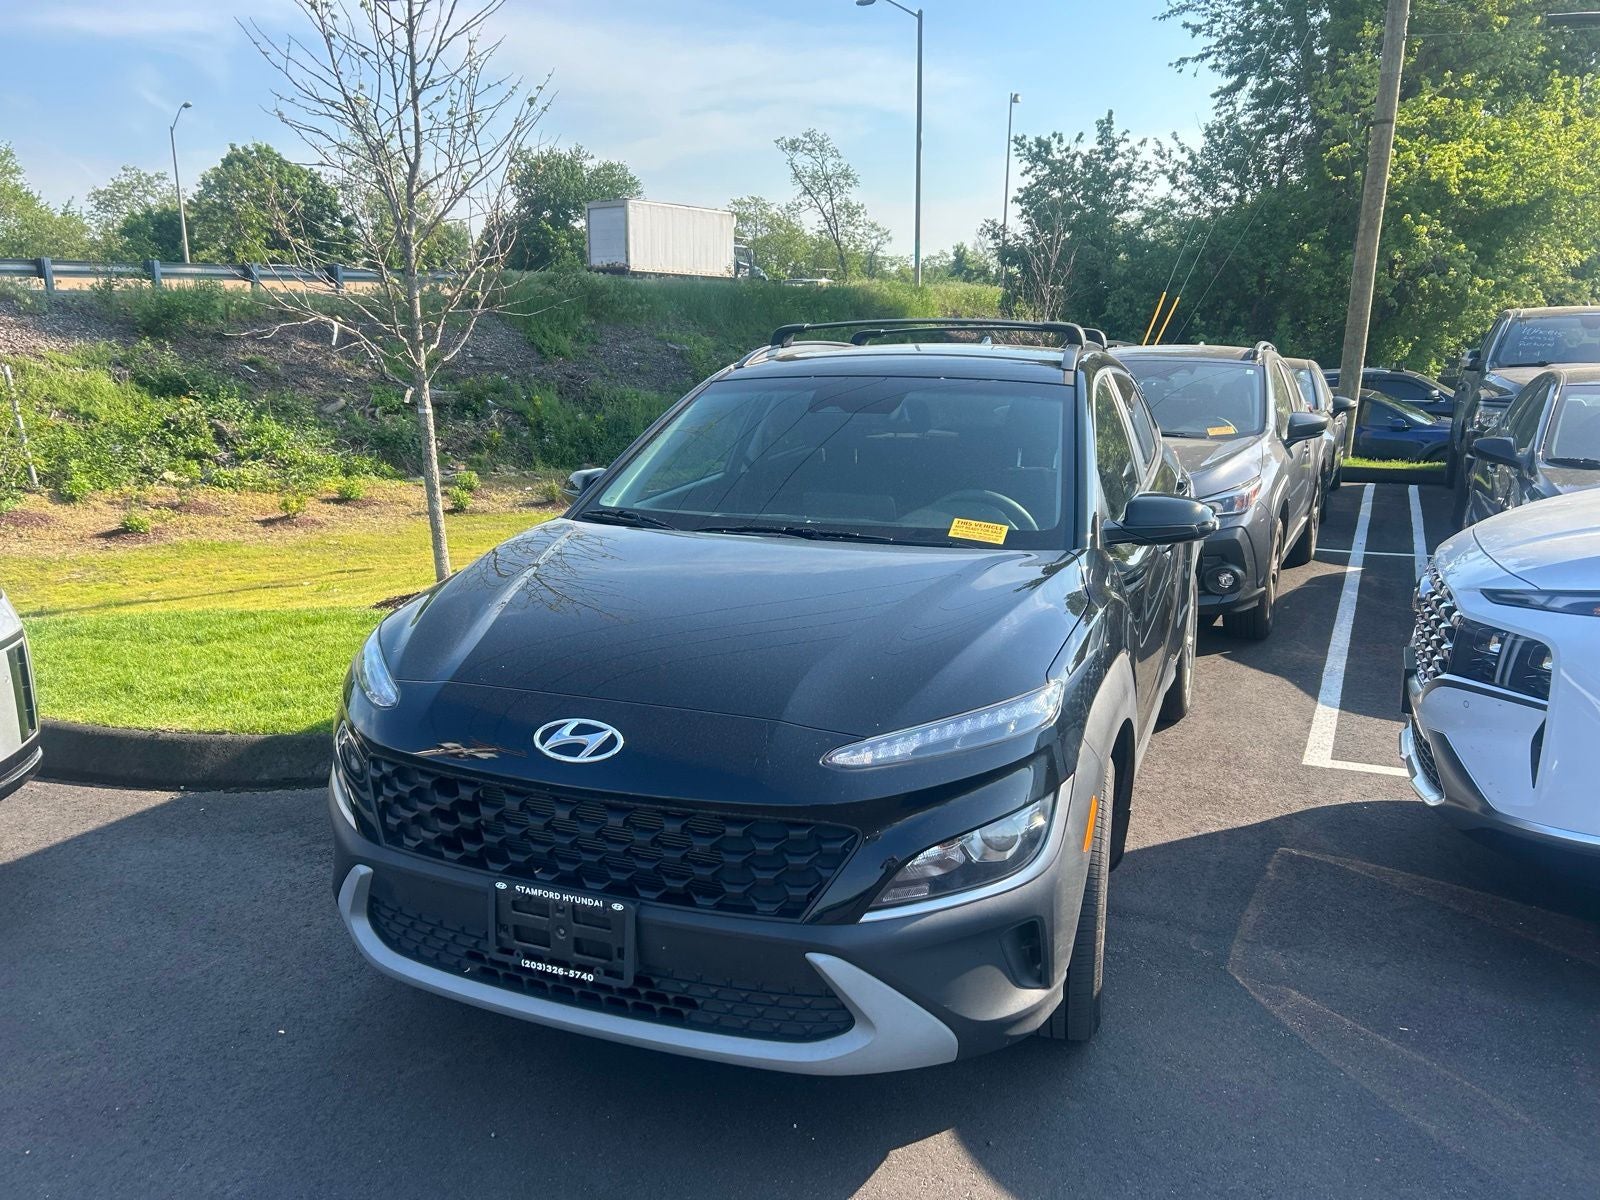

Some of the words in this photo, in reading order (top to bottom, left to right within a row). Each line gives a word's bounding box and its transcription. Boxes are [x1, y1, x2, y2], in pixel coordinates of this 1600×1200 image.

[974, 522, 1004, 531] VEHICLE
[515, 885, 561, 900] STAMFORD
[562, 894, 603, 908] HYUNDAI
[521, 959, 594, 982] (203)326-5740
